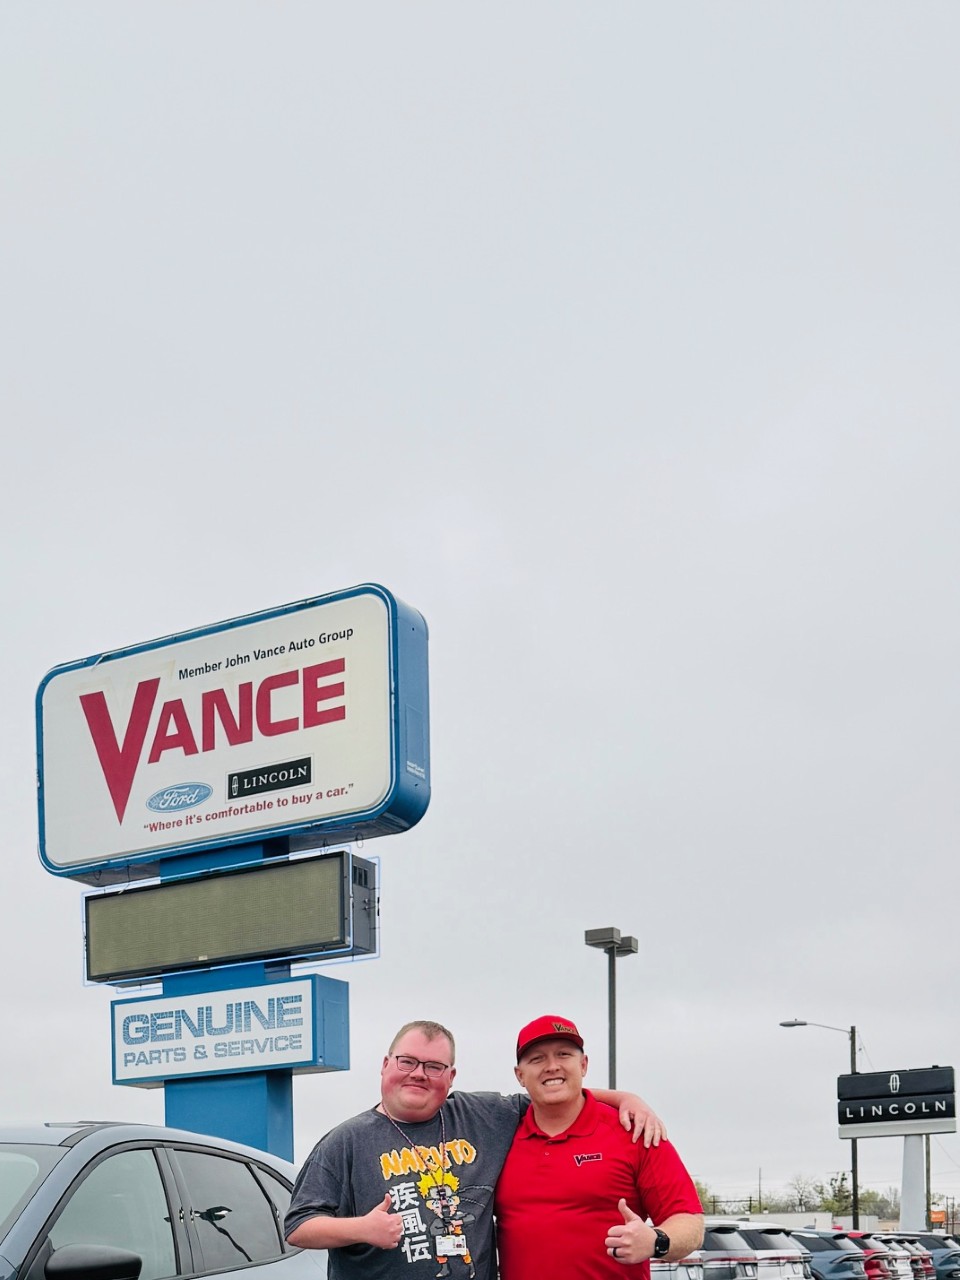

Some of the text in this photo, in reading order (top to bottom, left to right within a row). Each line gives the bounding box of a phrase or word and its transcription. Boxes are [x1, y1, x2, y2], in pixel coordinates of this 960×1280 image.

[178, 628, 354, 680] Member John Vance Auto Group
[79, 657, 346, 826] VANCE
[243, 765, 308, 789] LINCOLN
[158, 786, 200, 810] Ford
[205, 799, 274, 822] comfortable
[276, 796, 289, 807] to
[291, 793, 313, 805] buy
[315, 791, 323, 800] a
[122, 995, 303, 1046] GENUINE
[124, 1034, 303, 1067] PARTS & SERVICE
[845, 1101, 946, 1118] LINCOLN
[380, 1139, 477, 1180] NARUTO
